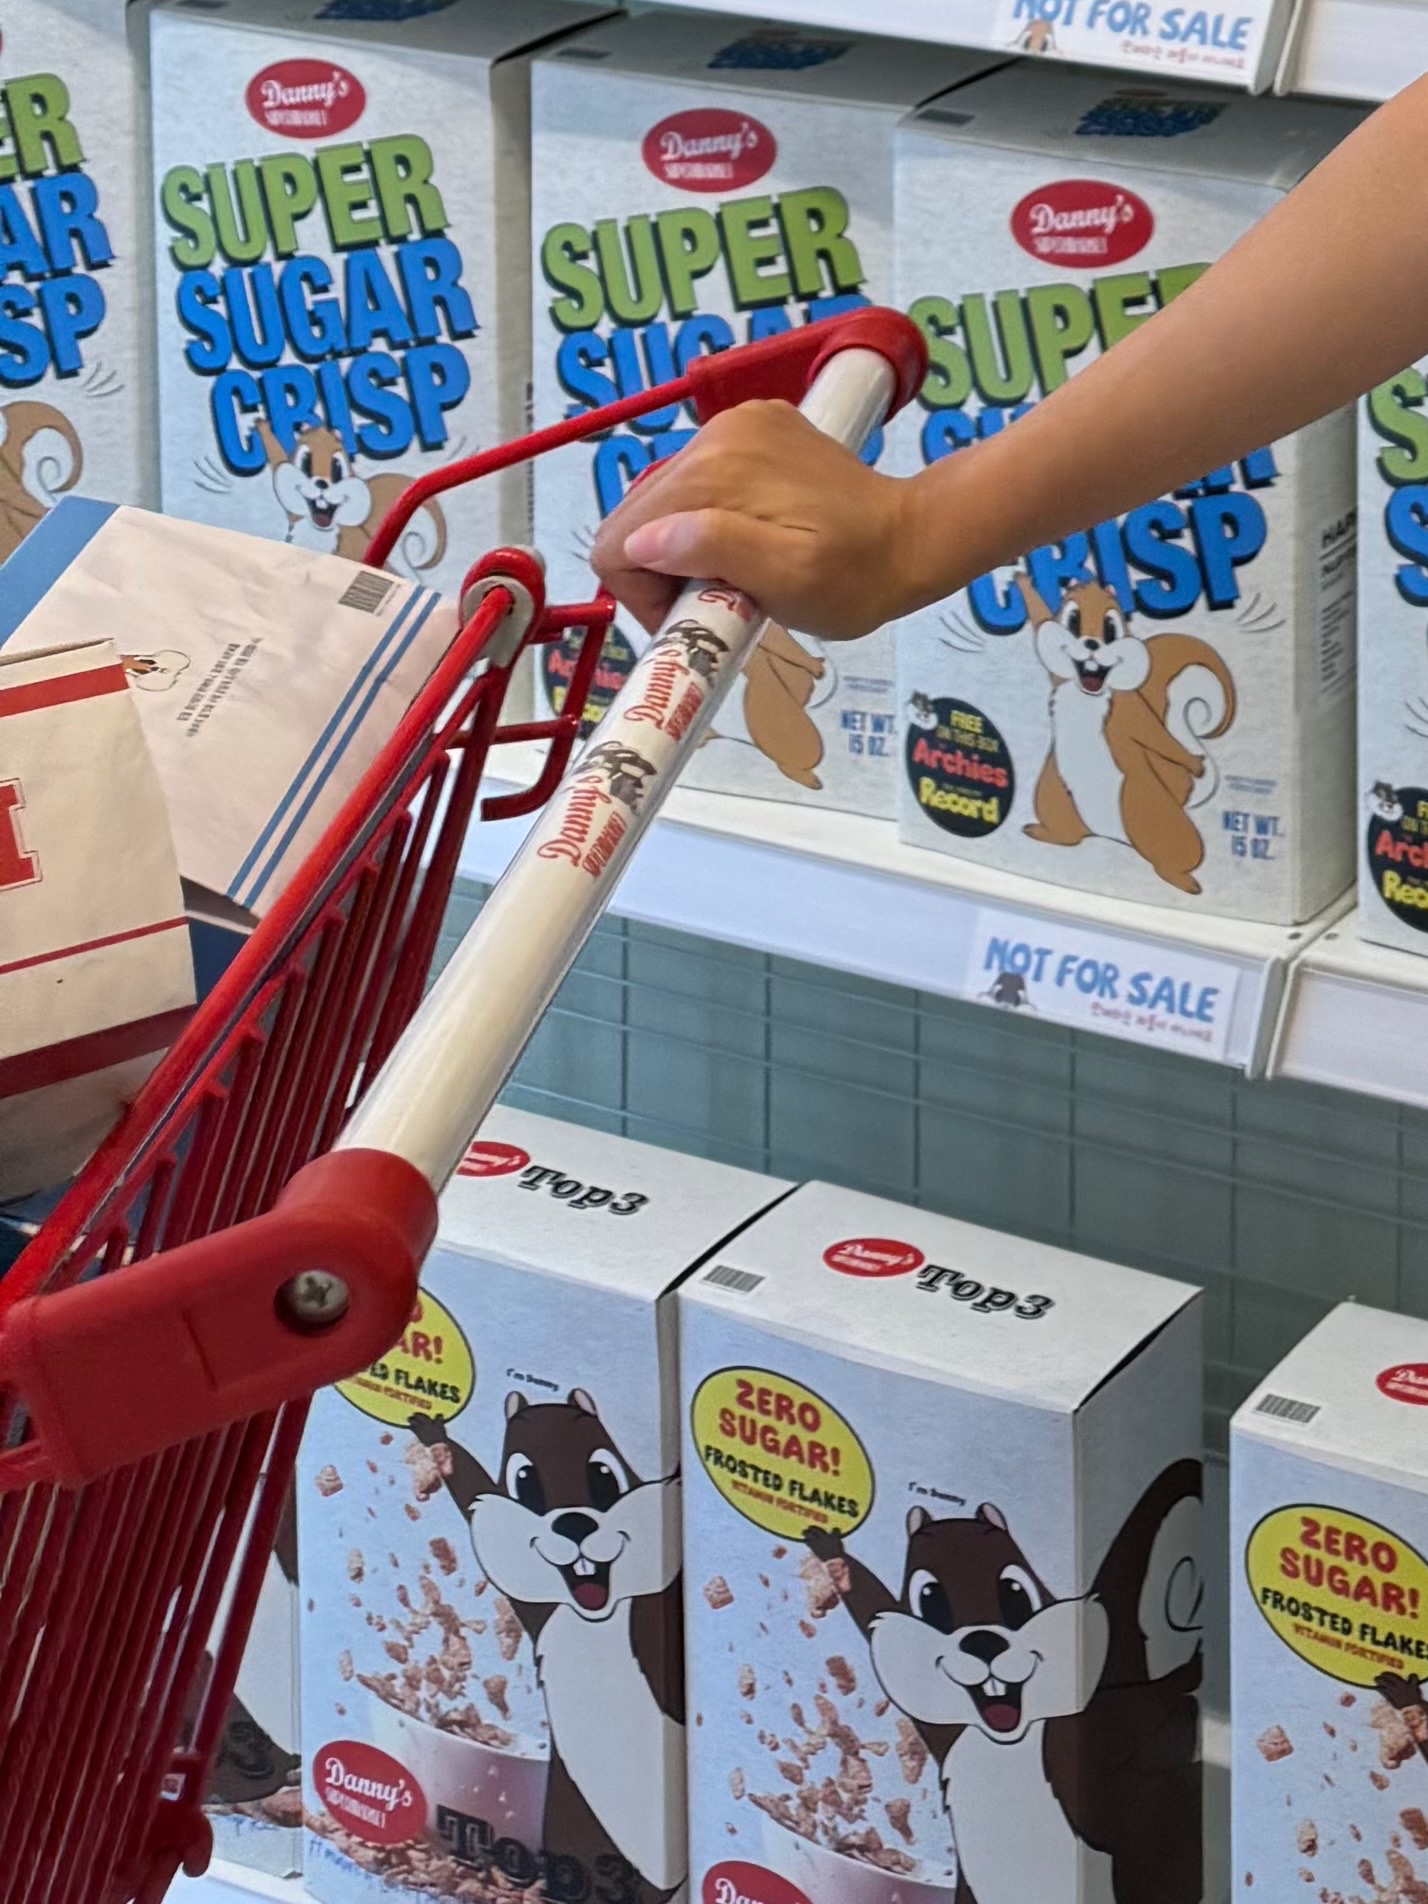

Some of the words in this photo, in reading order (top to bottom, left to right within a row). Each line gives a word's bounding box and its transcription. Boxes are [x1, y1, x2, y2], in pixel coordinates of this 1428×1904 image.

[1161, 6, 1253, 50] SALE
[261, 73, 348, 109] Danny's
[660, 124, 758, 160] Danny's
[161, 134, 452, 270] SUPER
[1030, 192, 1135, 236] Danny's
[542, 186, 868, 333] SUPER
[176, 237, 479, 376] SUGAR
[908, 262, 1213, 411] SUPE
[210, 343, 471, 477] CRISP
[624, 649, 690, 730] Danny's
[950, 710, 982, 733] FREE
[912, 738, 1008, 788] Archies
[538, 775, 612, 867] Danny's
[919, 776, 999, 823] Record
[1224, 809, 1254, 836] NET
[984, 937, 1049, 974] NOT
[1056, 952, 1121, 993] FOR
[1127, 970, 1220, 1023] SALE
[519, 1161, 652, 1220] Top3
[917, 1264, 1055, 1319] Top3
[395, 1368, 461, 1404] FLAKES
[736, 1379, 821, 1433] ZERO
[719, 1408, 840, 1476] SUGAR!
[703, 1444, 782, 1493] FROSTED
[789, 1483, 858, 1517] FLAKES
[1300, 1517, 1397, 1573] ZERO
[1261, 1587, 1352, 1636] FROSTED
[1280, 1548, 1419, 1620] SUGAR!
[325, 1757, 412, 1812] Danny's
